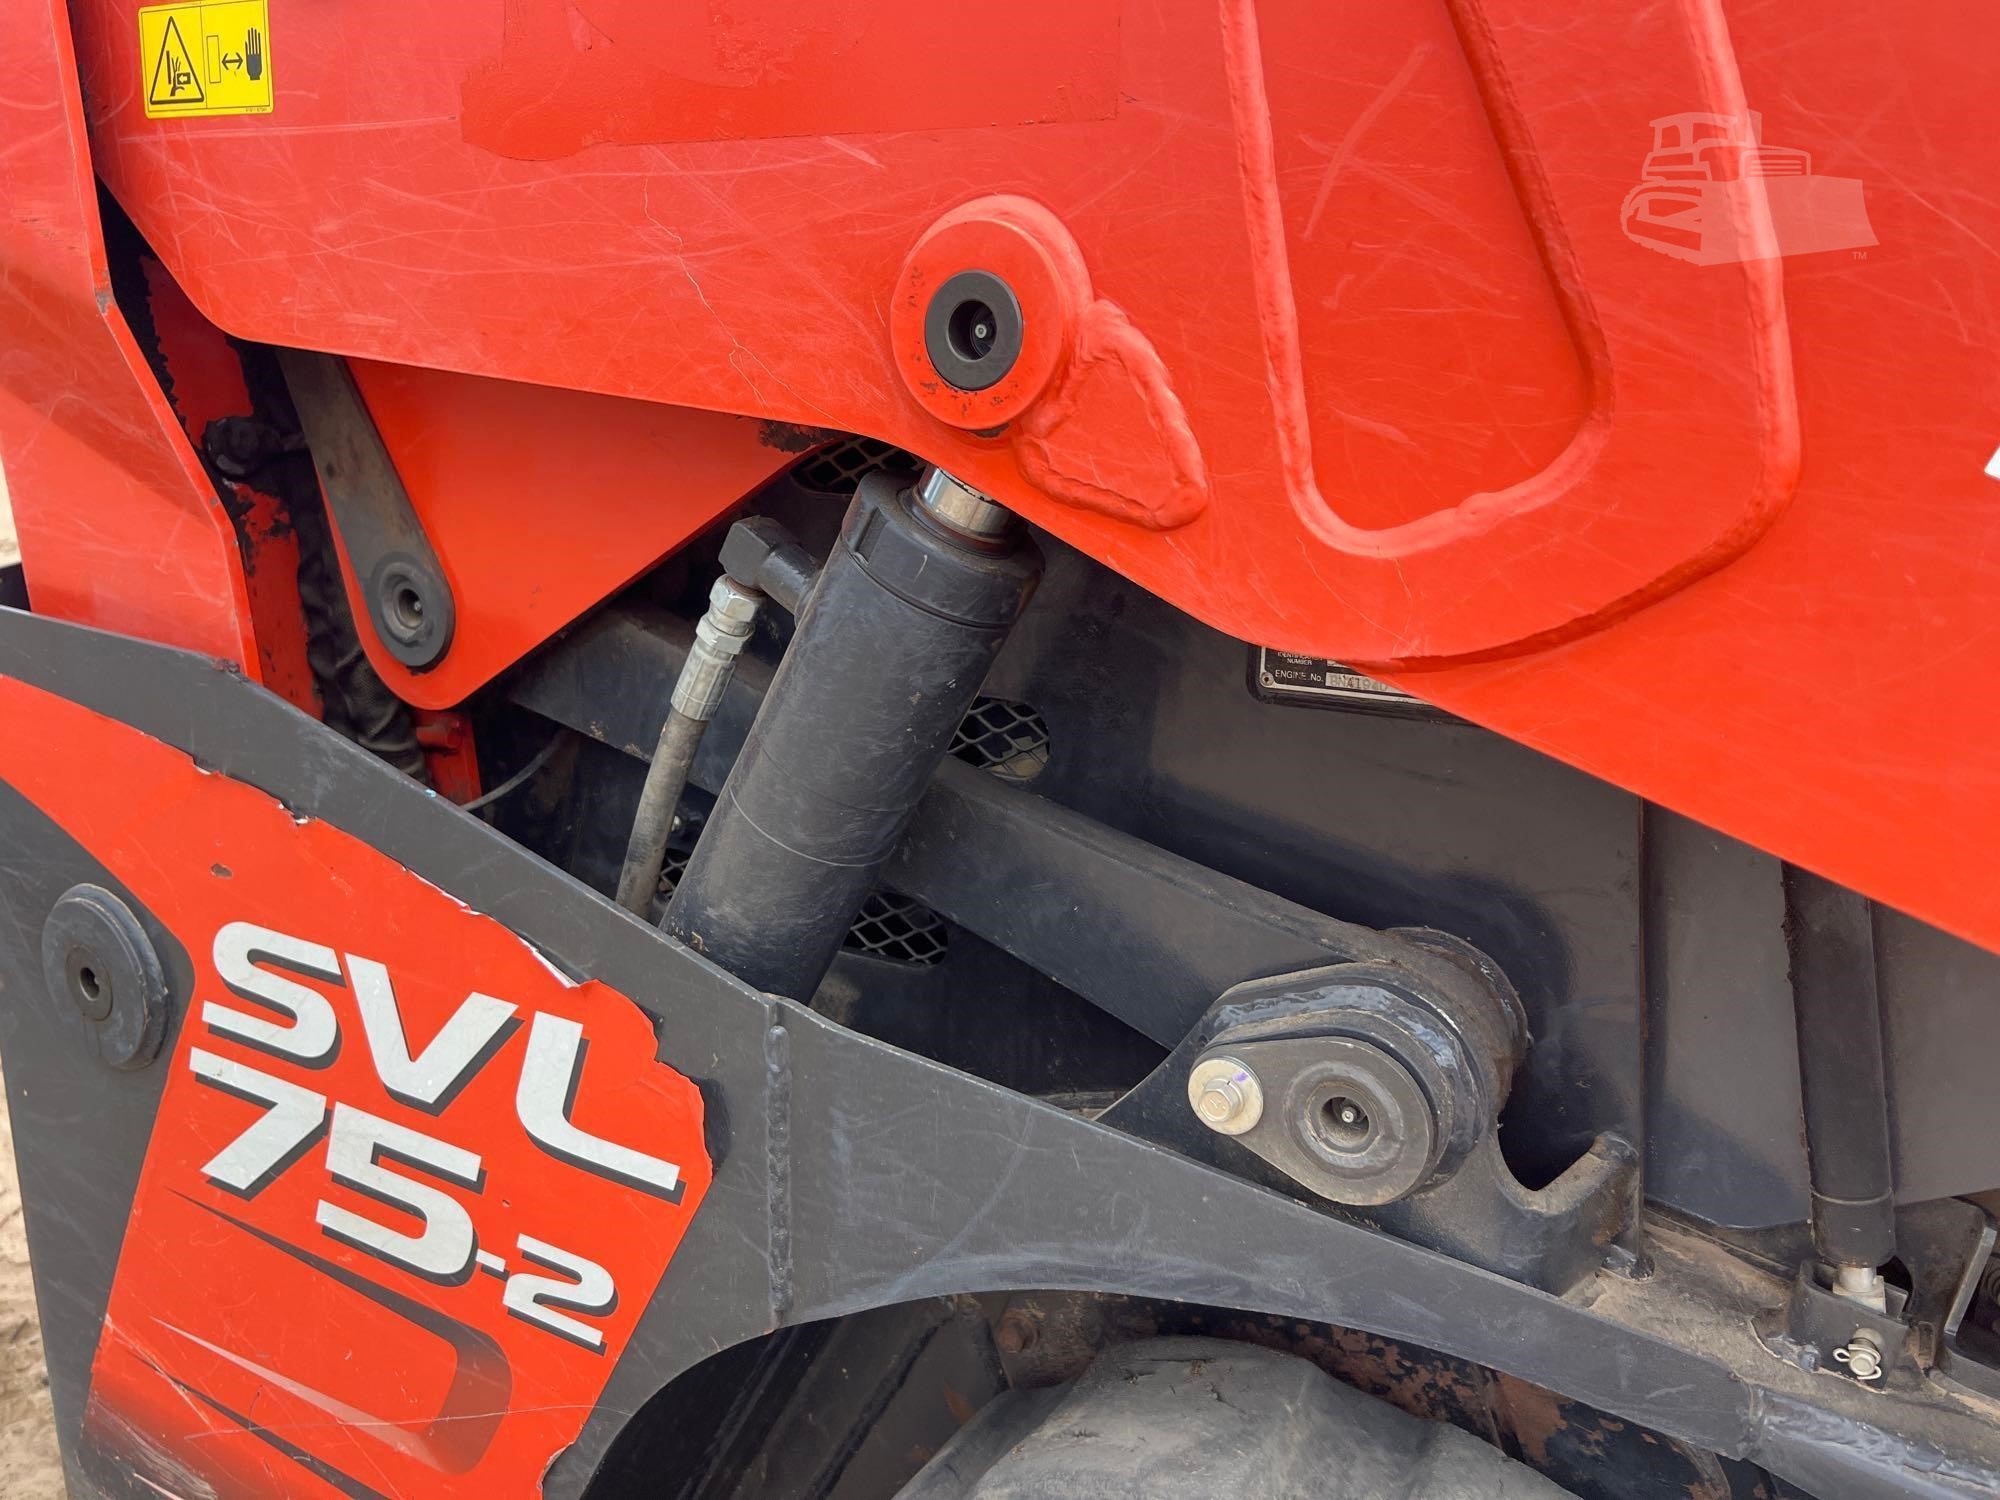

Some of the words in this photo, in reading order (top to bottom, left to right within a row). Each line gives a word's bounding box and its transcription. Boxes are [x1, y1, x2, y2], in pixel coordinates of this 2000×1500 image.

[1275, 669, 1307, 681] ENGINE
[189, 1047, 617, 1351] 75-2
[202, 921, 683, 1203] SVL
